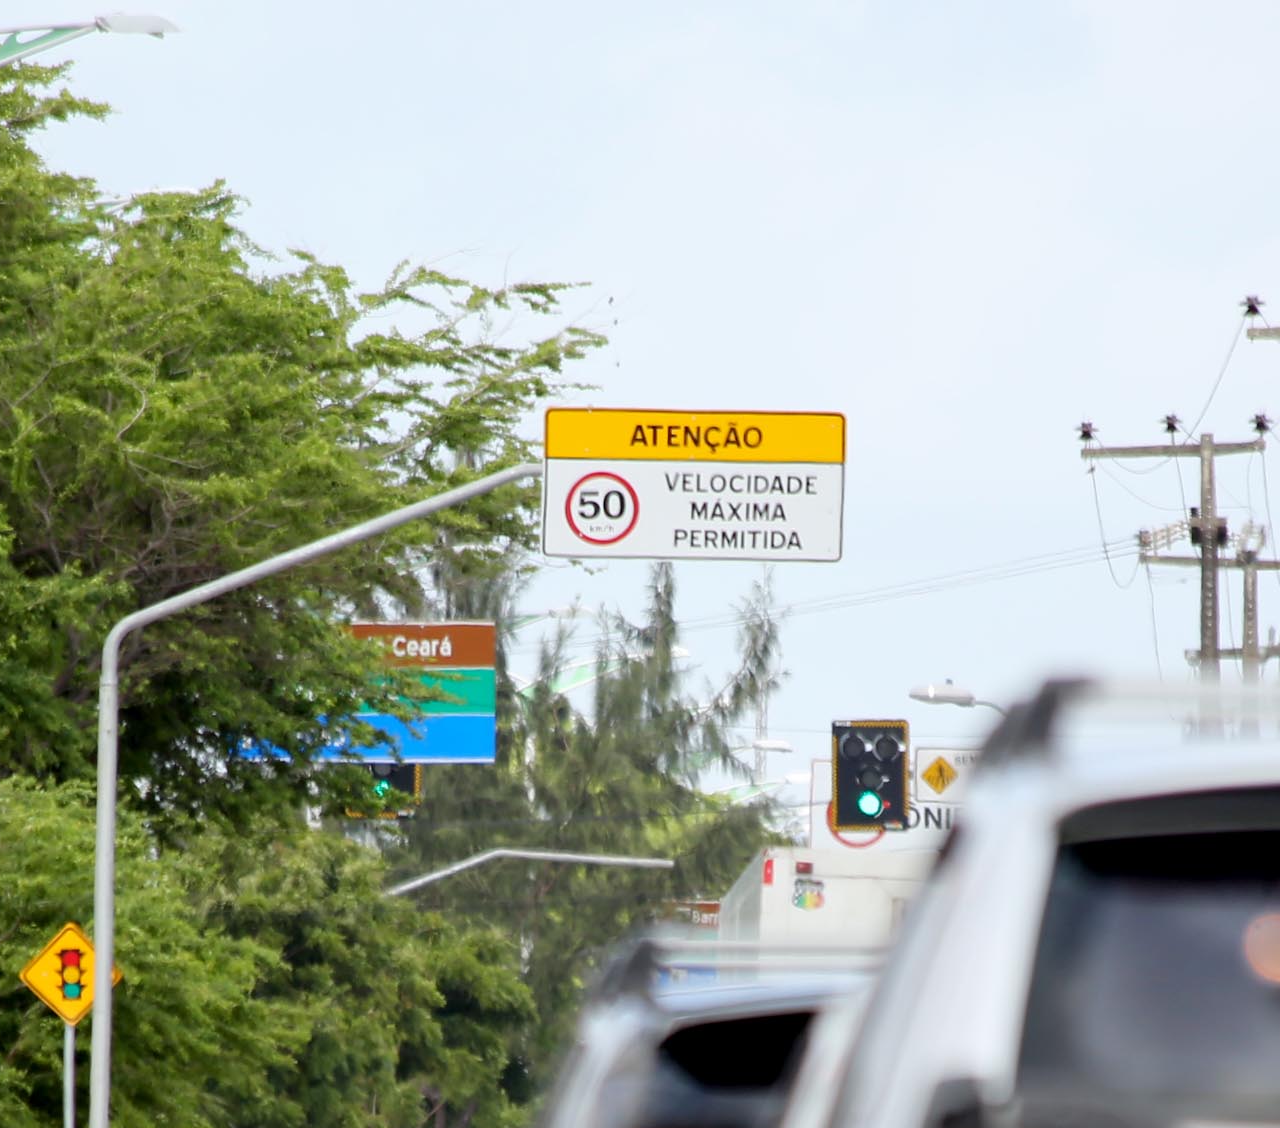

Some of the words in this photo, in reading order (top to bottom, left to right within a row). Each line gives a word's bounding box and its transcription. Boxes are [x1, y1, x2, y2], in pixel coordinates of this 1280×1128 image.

[630, 422, 763, 454] ATENÇÃO
[665, 472, 818, 495] VELOCIDADE
[578, 490, 626, 519] 50
[690, 497, 787, 522] MÁXIMA
[673, 529, 803, 550] PERMITIDA
[392, 635, 452, 658] Ceará
